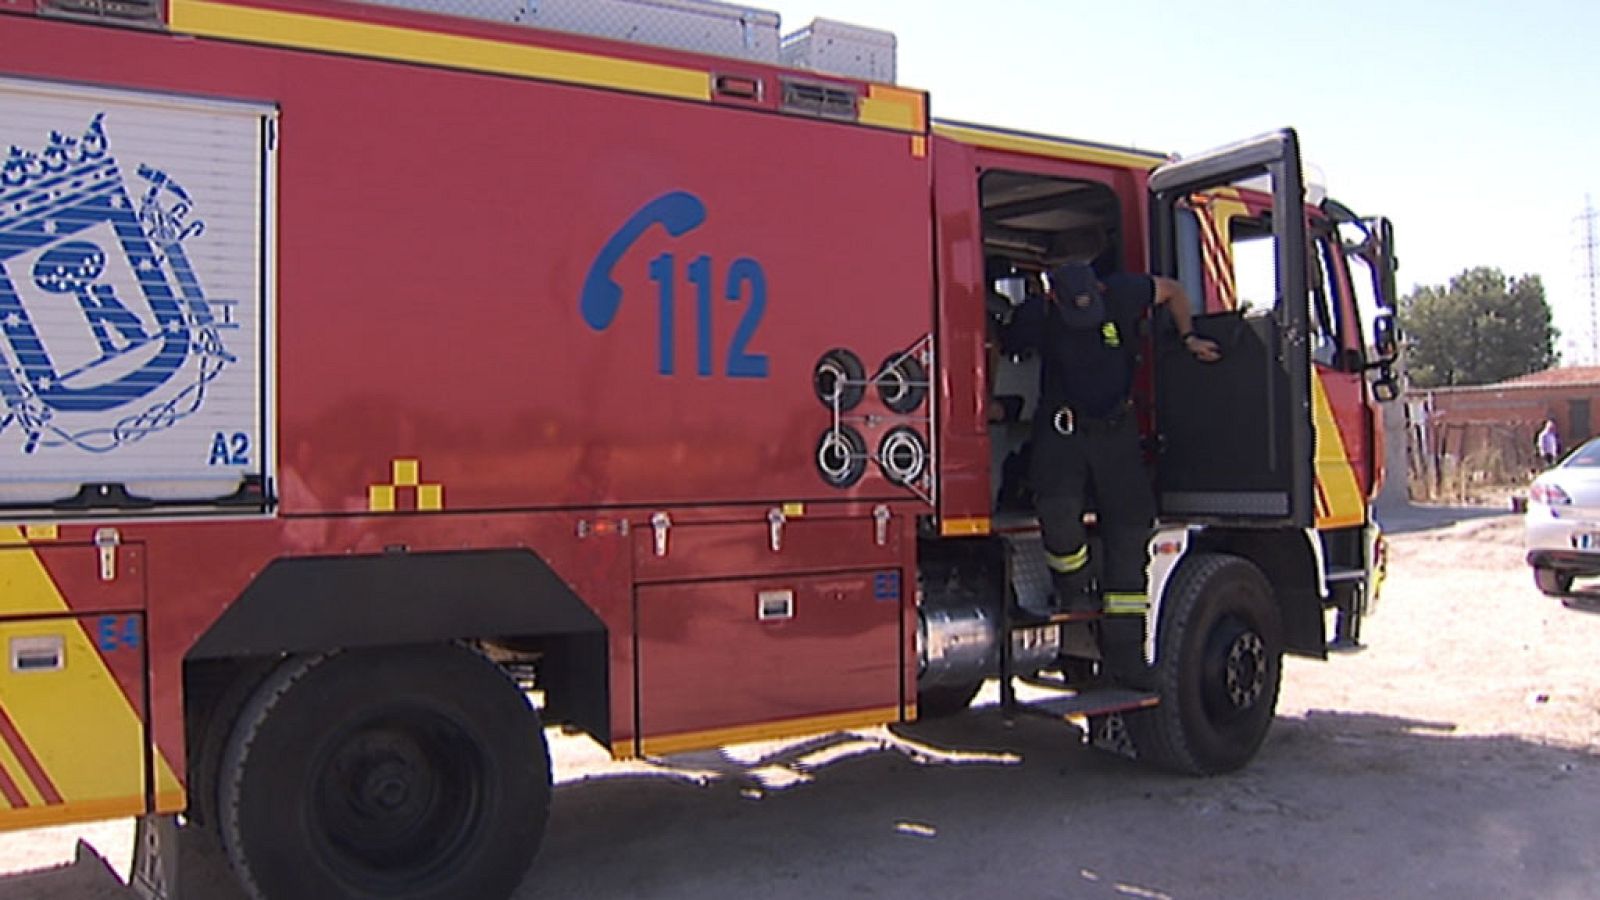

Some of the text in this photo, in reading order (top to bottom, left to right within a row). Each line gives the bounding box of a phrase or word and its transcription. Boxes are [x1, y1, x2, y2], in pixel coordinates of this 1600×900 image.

[649, 252, 769, 378] 112
[209, 431, 249, 465] A2
[98, 615, 140, 652] E4
